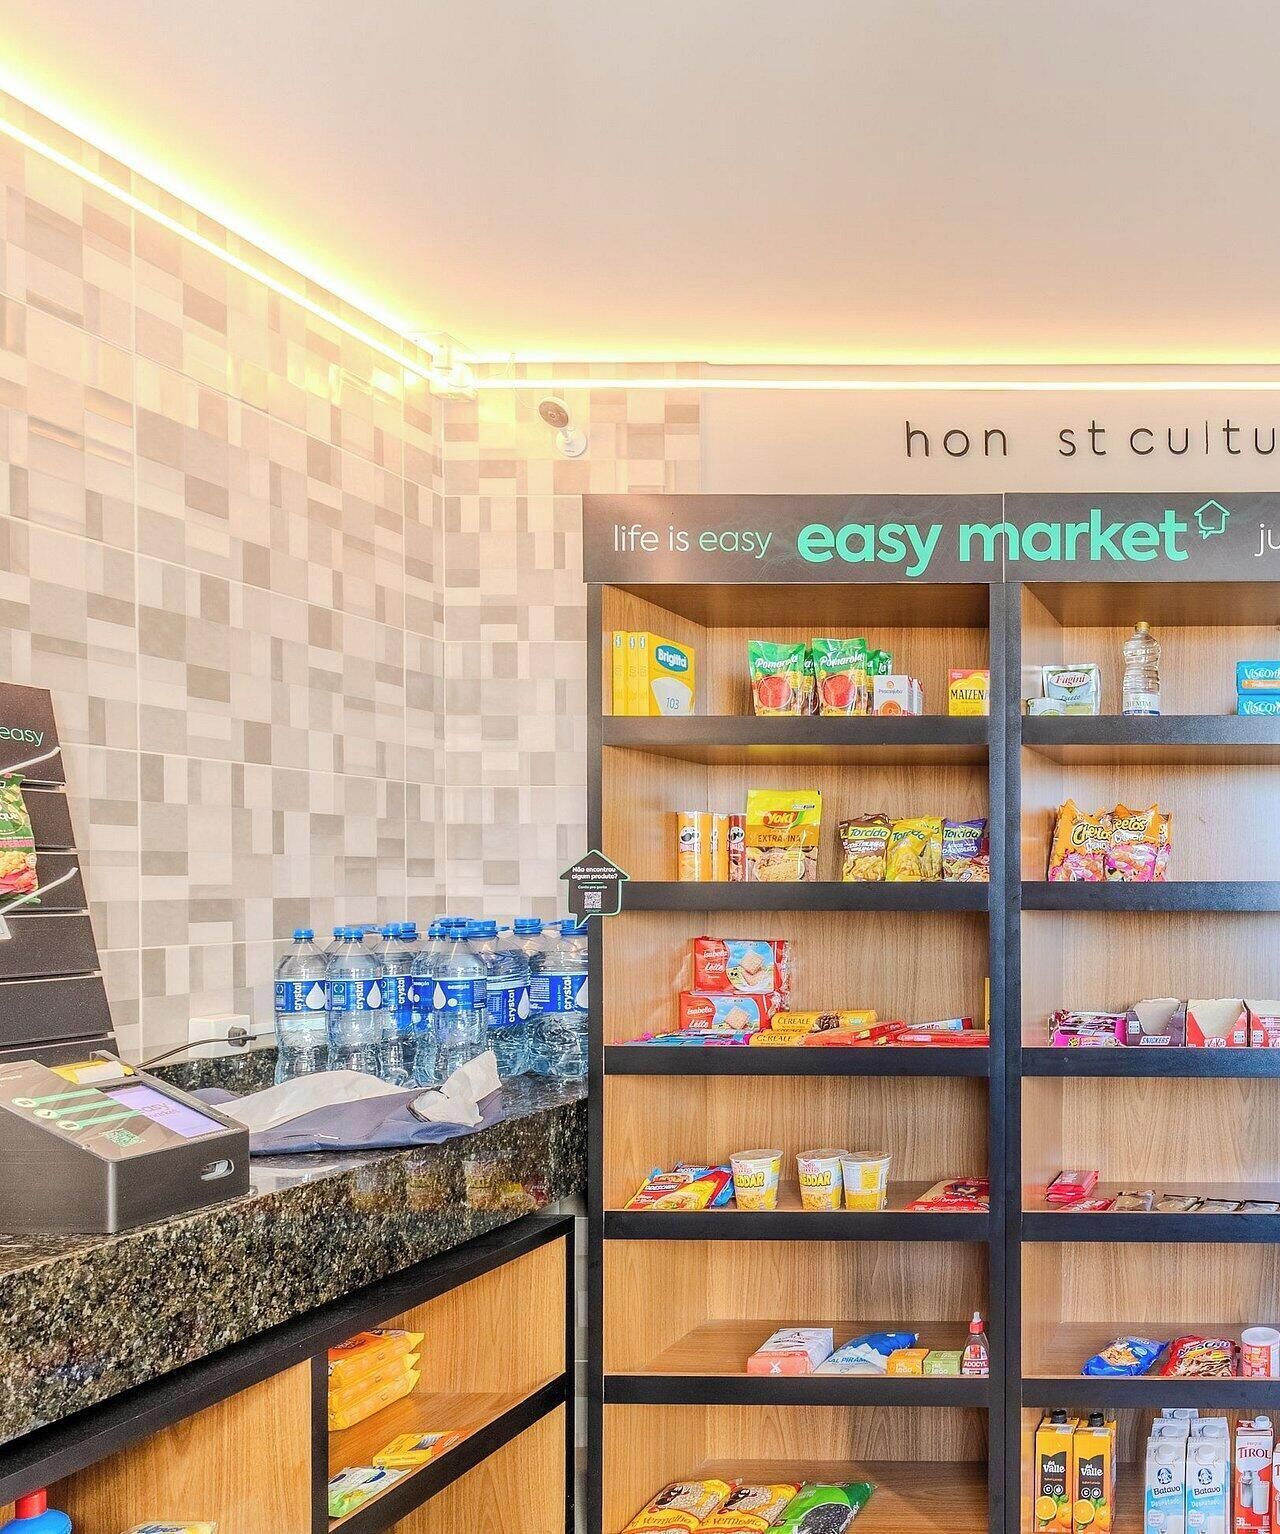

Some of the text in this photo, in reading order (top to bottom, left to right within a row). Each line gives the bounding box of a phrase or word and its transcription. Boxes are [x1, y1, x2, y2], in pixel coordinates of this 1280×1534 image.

[613, 524, 773, 559] life is easy
[797, 509, 1190, 577] easy market
[950, 688, 989, 700] MAIZEN
[666, 697, 680, 710] 103
[0, 726, 44, 747] easy
[767, 812, 794, 825] Yoki
[562, 976, 575, 1011] crystal
[507, 989, 517, 1024] crystal
[1237, 1447, 1271, 1460] TIROL
[1153, 1485, 1181, 1496] Batavo
[1193, 1485, 1221, 1496] Batavo
